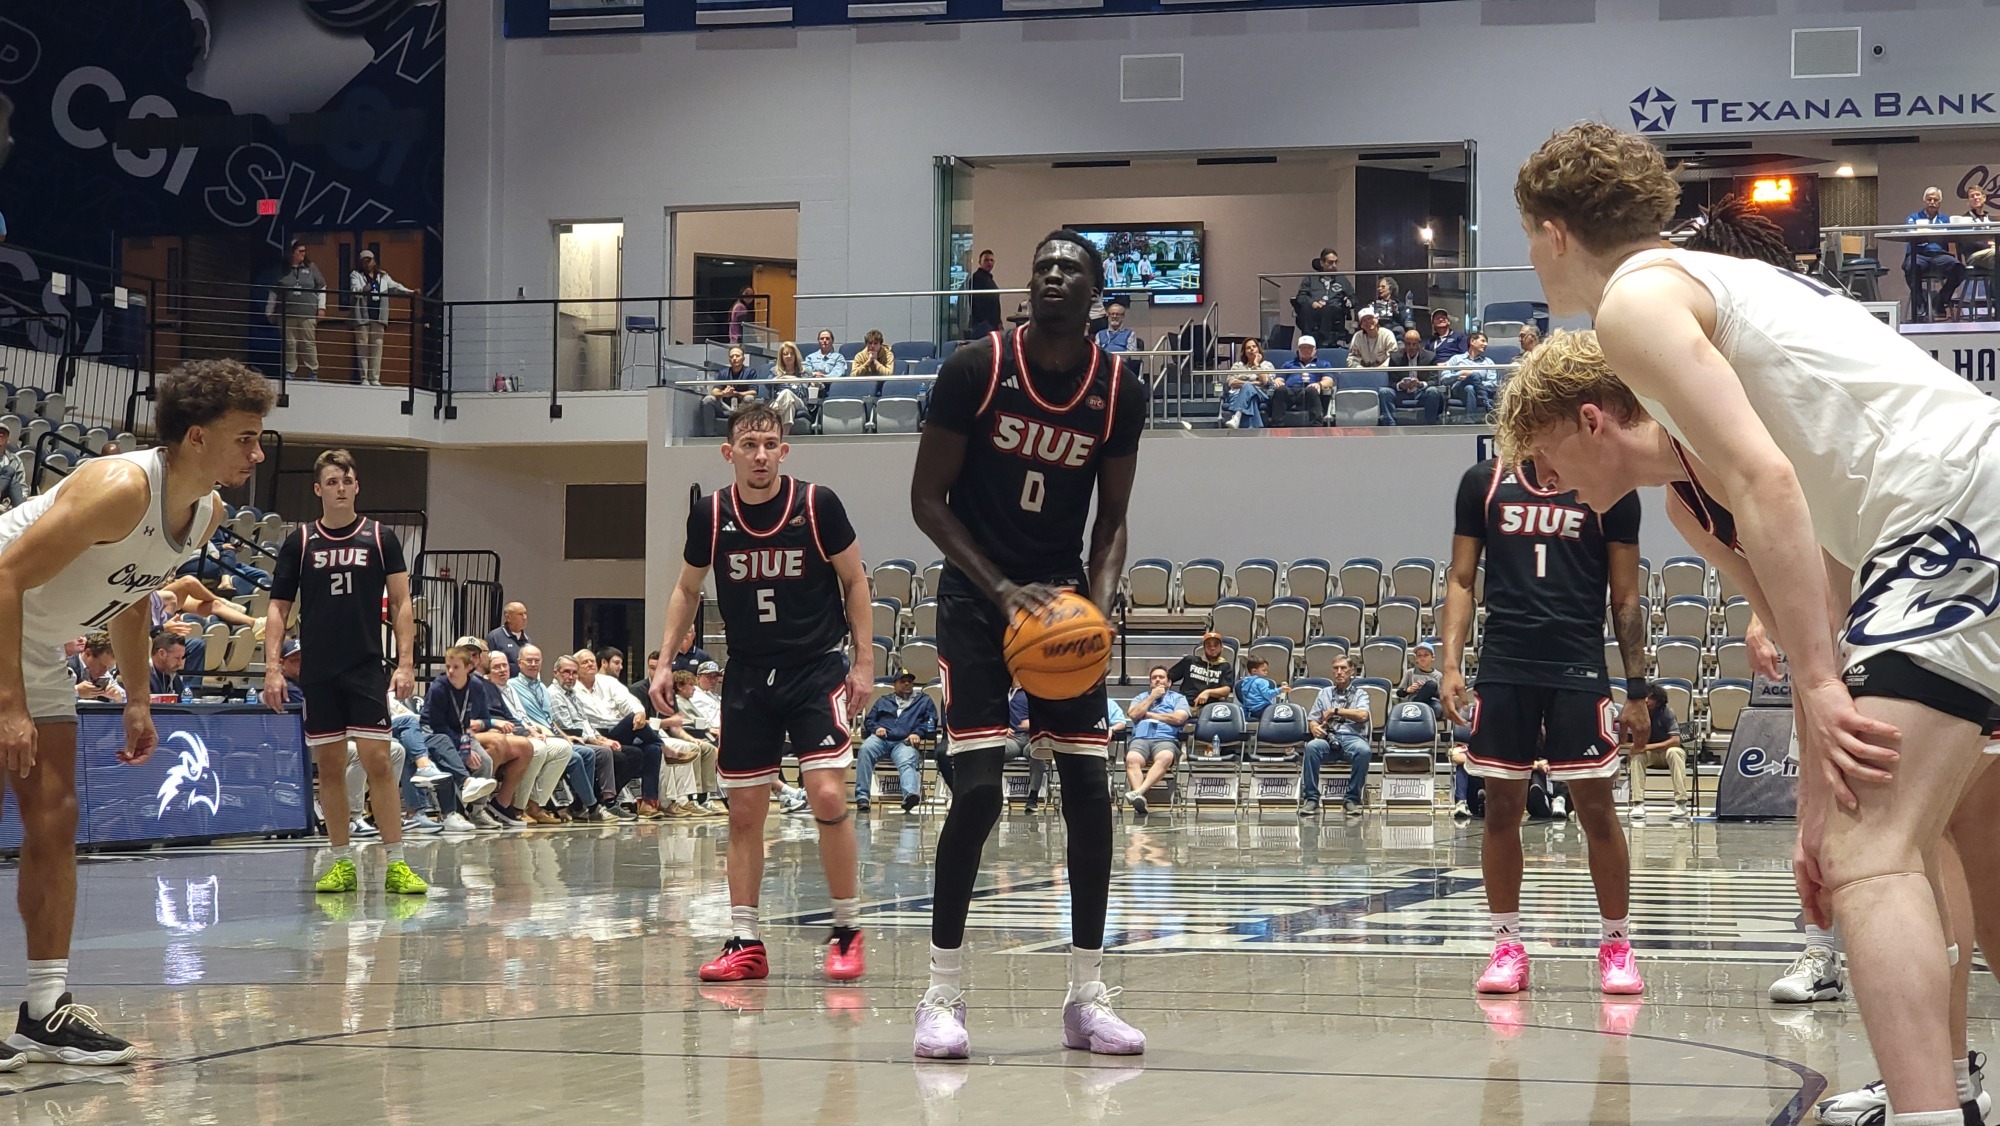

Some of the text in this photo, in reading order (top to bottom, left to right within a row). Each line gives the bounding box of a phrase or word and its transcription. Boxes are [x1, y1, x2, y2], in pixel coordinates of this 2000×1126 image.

[1692, 92, 1997, 123] TEXANA BANK
[1952, 348, 2000, 381] HA
[992, 413, 1096, 468] SIUE
[1020, 470, 1045, 513] 0
[1500, 505, 1585, 539] SIUE
[313, 548, 369, 569] SIUE
[727, 549, 804, 581] SIUE
[1534, 543, 1547, 578] 1
[330, 571, 352, 596] 21
[756, 588, 777, 623] 5
[1195, 784, 1231, 796] FLORIDA
[1202, 778, 1225, 786] NORTH
[1257, 784, 1293, 796] FLORIDA
[1264, 778, 1287, 786] NORTH
[1391, 785, 1426, 796] FLORIDA
